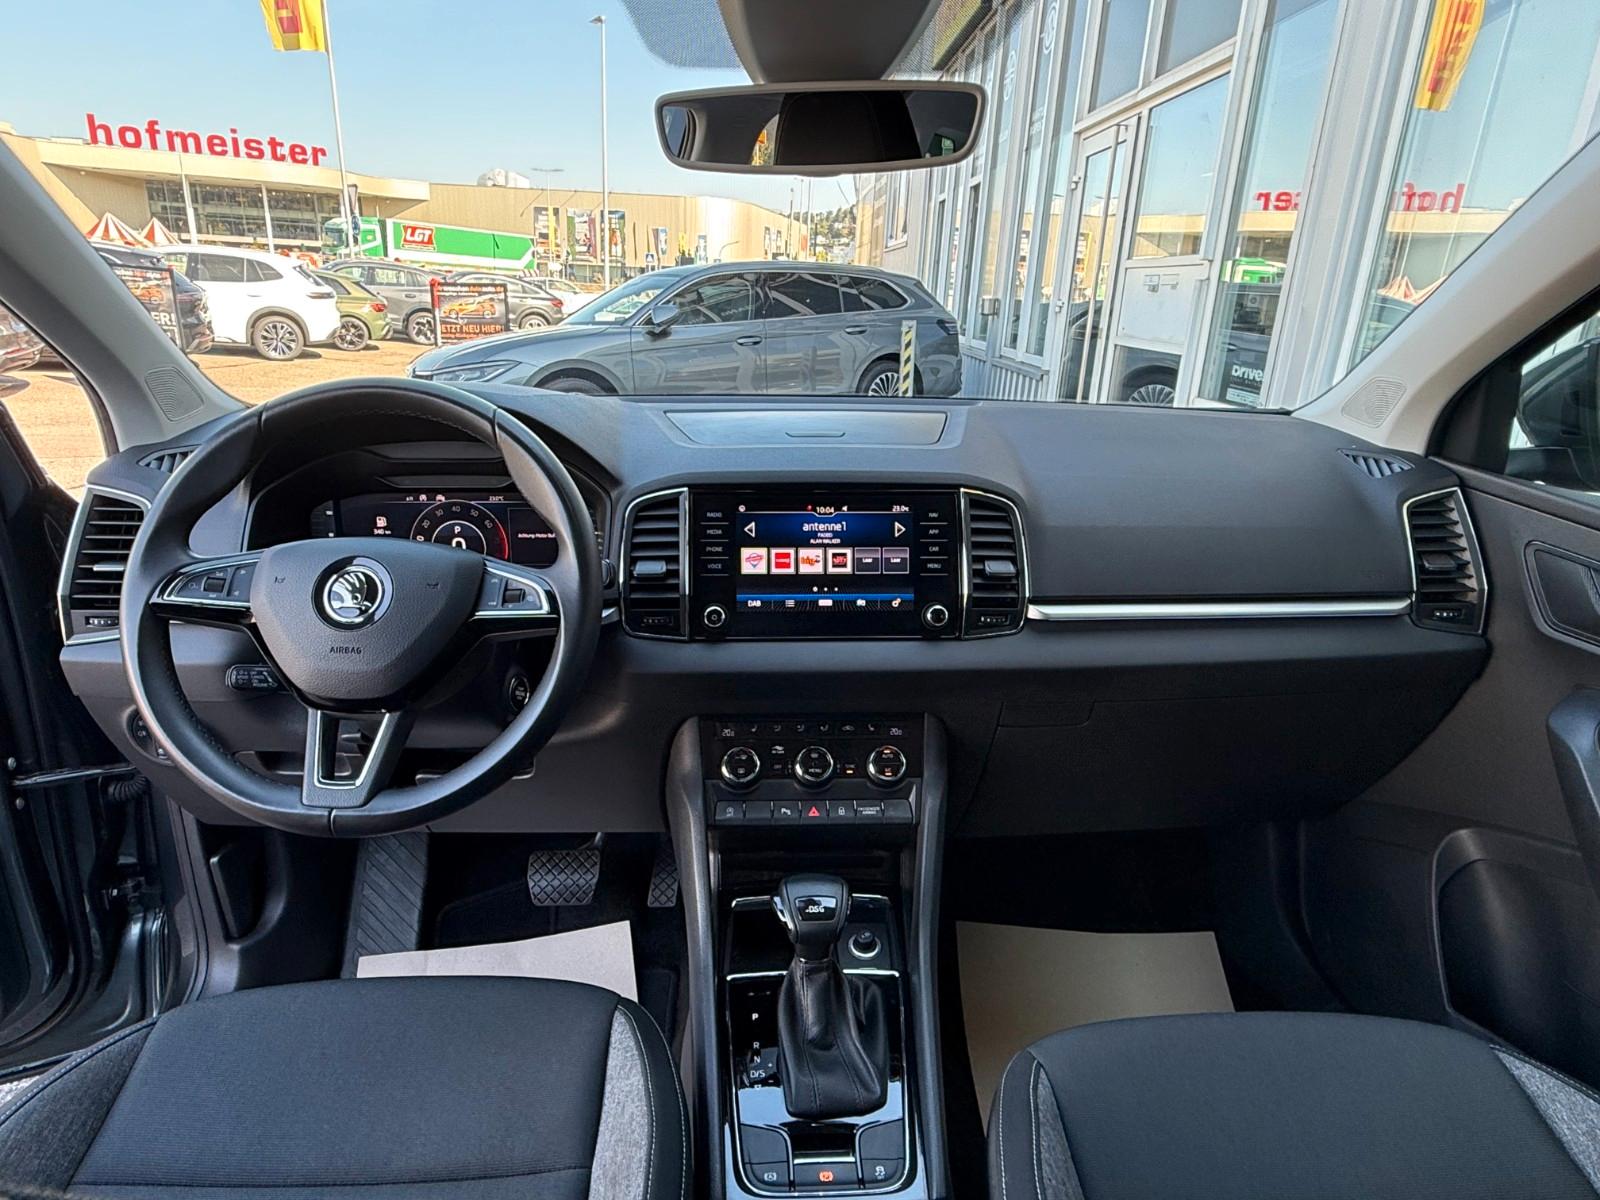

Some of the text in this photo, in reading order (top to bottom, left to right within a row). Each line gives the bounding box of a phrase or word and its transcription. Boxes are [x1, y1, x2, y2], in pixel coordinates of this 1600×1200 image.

[86, 113, 327, 166] hofmeister
[406, 227, 432, 242] LGT
[151, 311, 176, 326] ER!
[463, 324, 480, 333] NEU
[816, 506, 835, 514] 10:04
[454, 525, 462, 534] P
[802, 522, 847, 532] antenne1
[330, 646, 362, 655] AIRBAG
[752, 1013, 759, 1021] P
[753, 1041, 760, 1049] R
[754, 1055, 761, 1063] N
[750, 1069, 766, 1078] D/S
